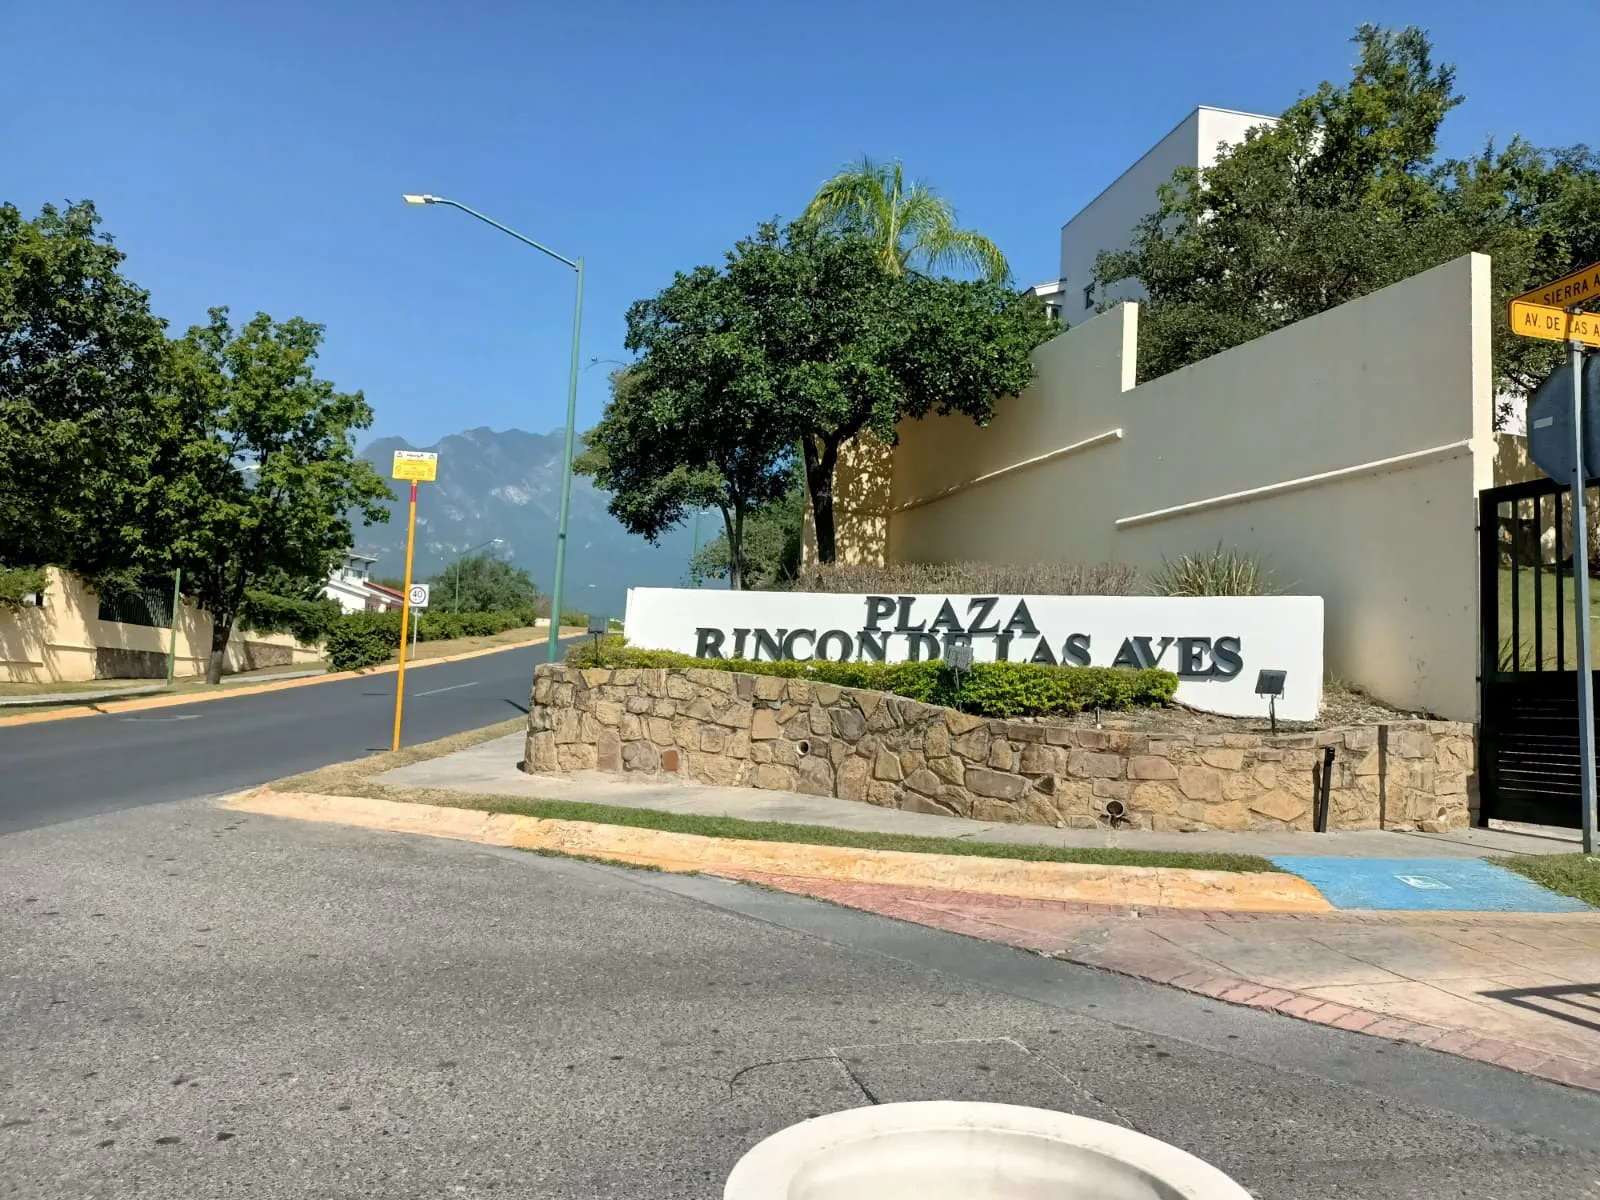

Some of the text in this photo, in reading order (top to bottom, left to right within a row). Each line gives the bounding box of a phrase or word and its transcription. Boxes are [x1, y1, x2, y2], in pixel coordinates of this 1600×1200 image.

[1543, 279, 1589, 306] SIERRA
[1525, 312, 1541, 328] AV.
[1546, 316, 1561, 331] DE
[1568, 321, 1588, 335] LAS
[412, 590, 423, 598] 40
[863, 596, 1040, 635] PLAZA
[695, 627, 892, 664] RINCON
[994, 632, 1092, 668] LAS
[1111, 635, 1244, 678] AVES
